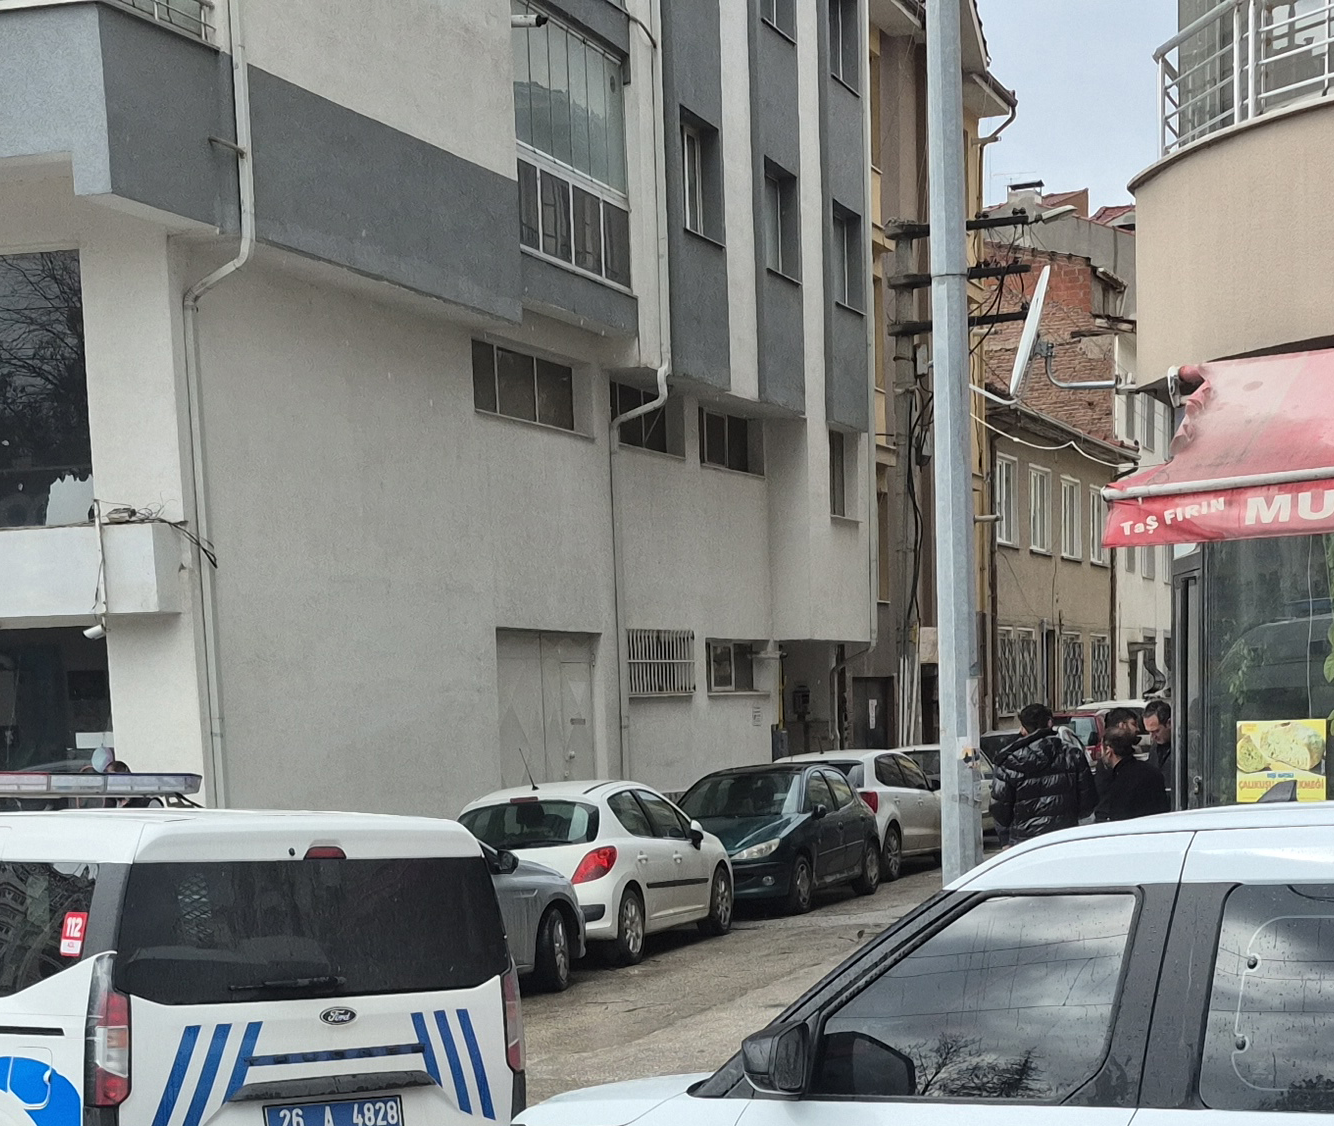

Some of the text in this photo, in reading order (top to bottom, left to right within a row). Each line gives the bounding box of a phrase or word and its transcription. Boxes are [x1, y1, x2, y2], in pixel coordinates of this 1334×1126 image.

[1163, 497, 1225, 525] FIRIN
[65, 916, 83, 938] 112
[328, 1009, 352, 1022] Ford
